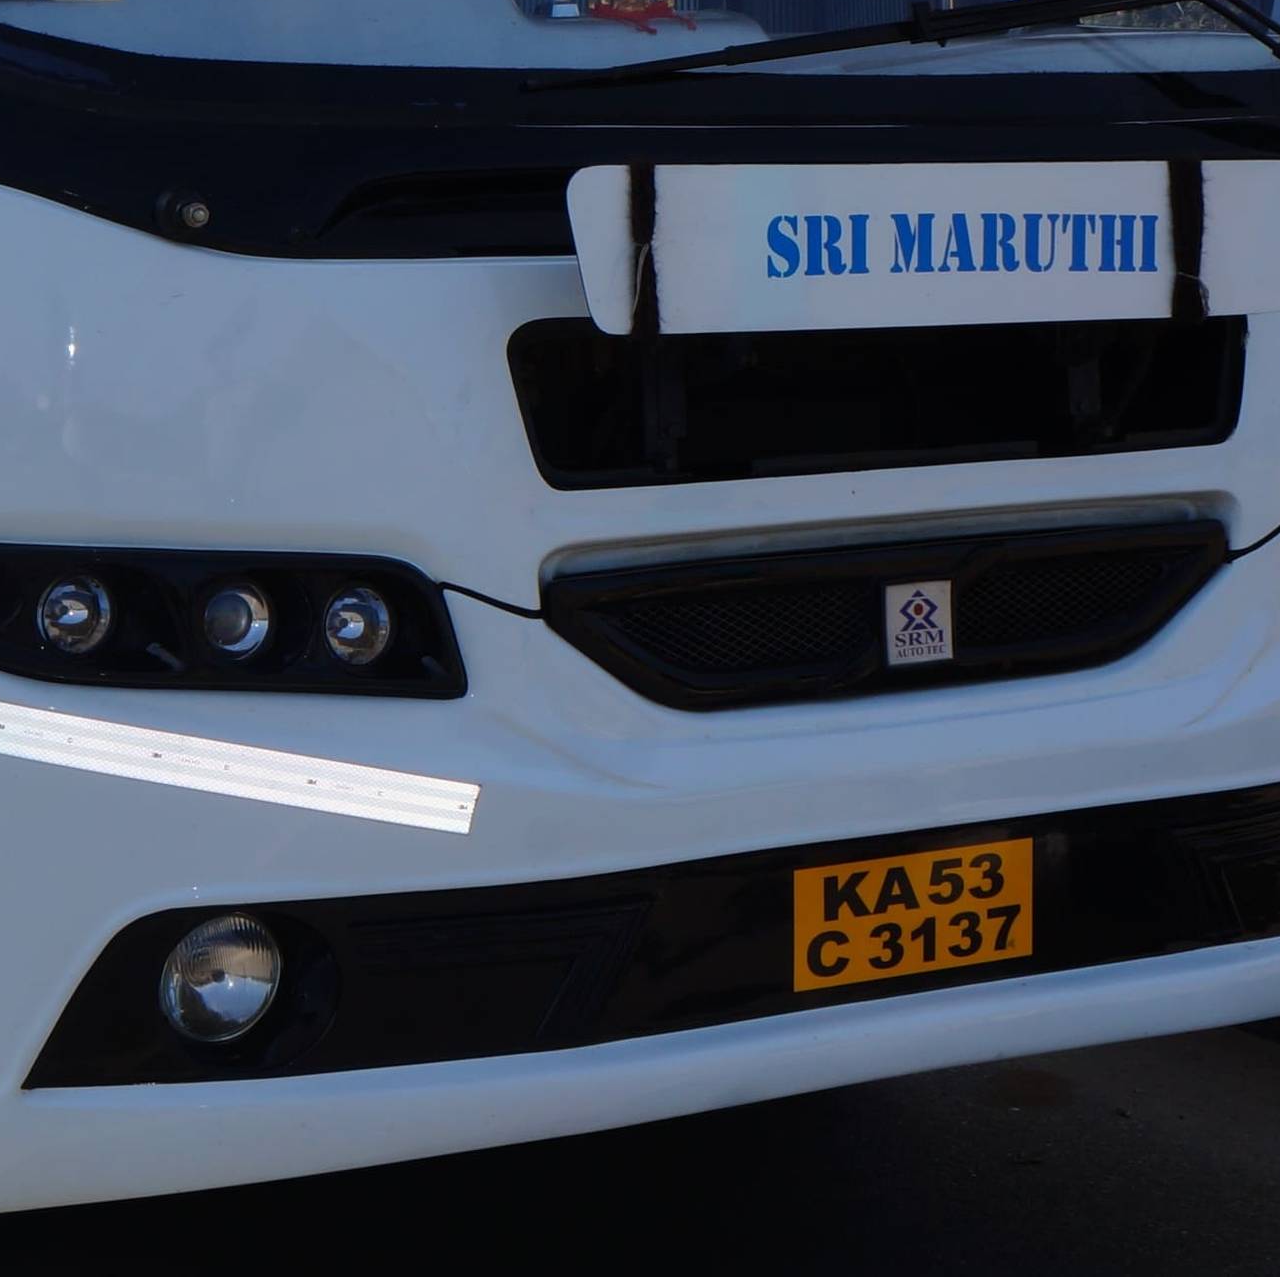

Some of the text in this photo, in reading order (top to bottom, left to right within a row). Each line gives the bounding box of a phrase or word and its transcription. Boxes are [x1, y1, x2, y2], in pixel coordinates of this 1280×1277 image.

[766, 212, 1159, 279] SRI MARUTHI
[894, 629, 945, 648] SRM
[897, 647, 924, 658] AUTO
[823, 853, 1005, 922] KA 53
[806, 904, 1021, 978] C 3137
